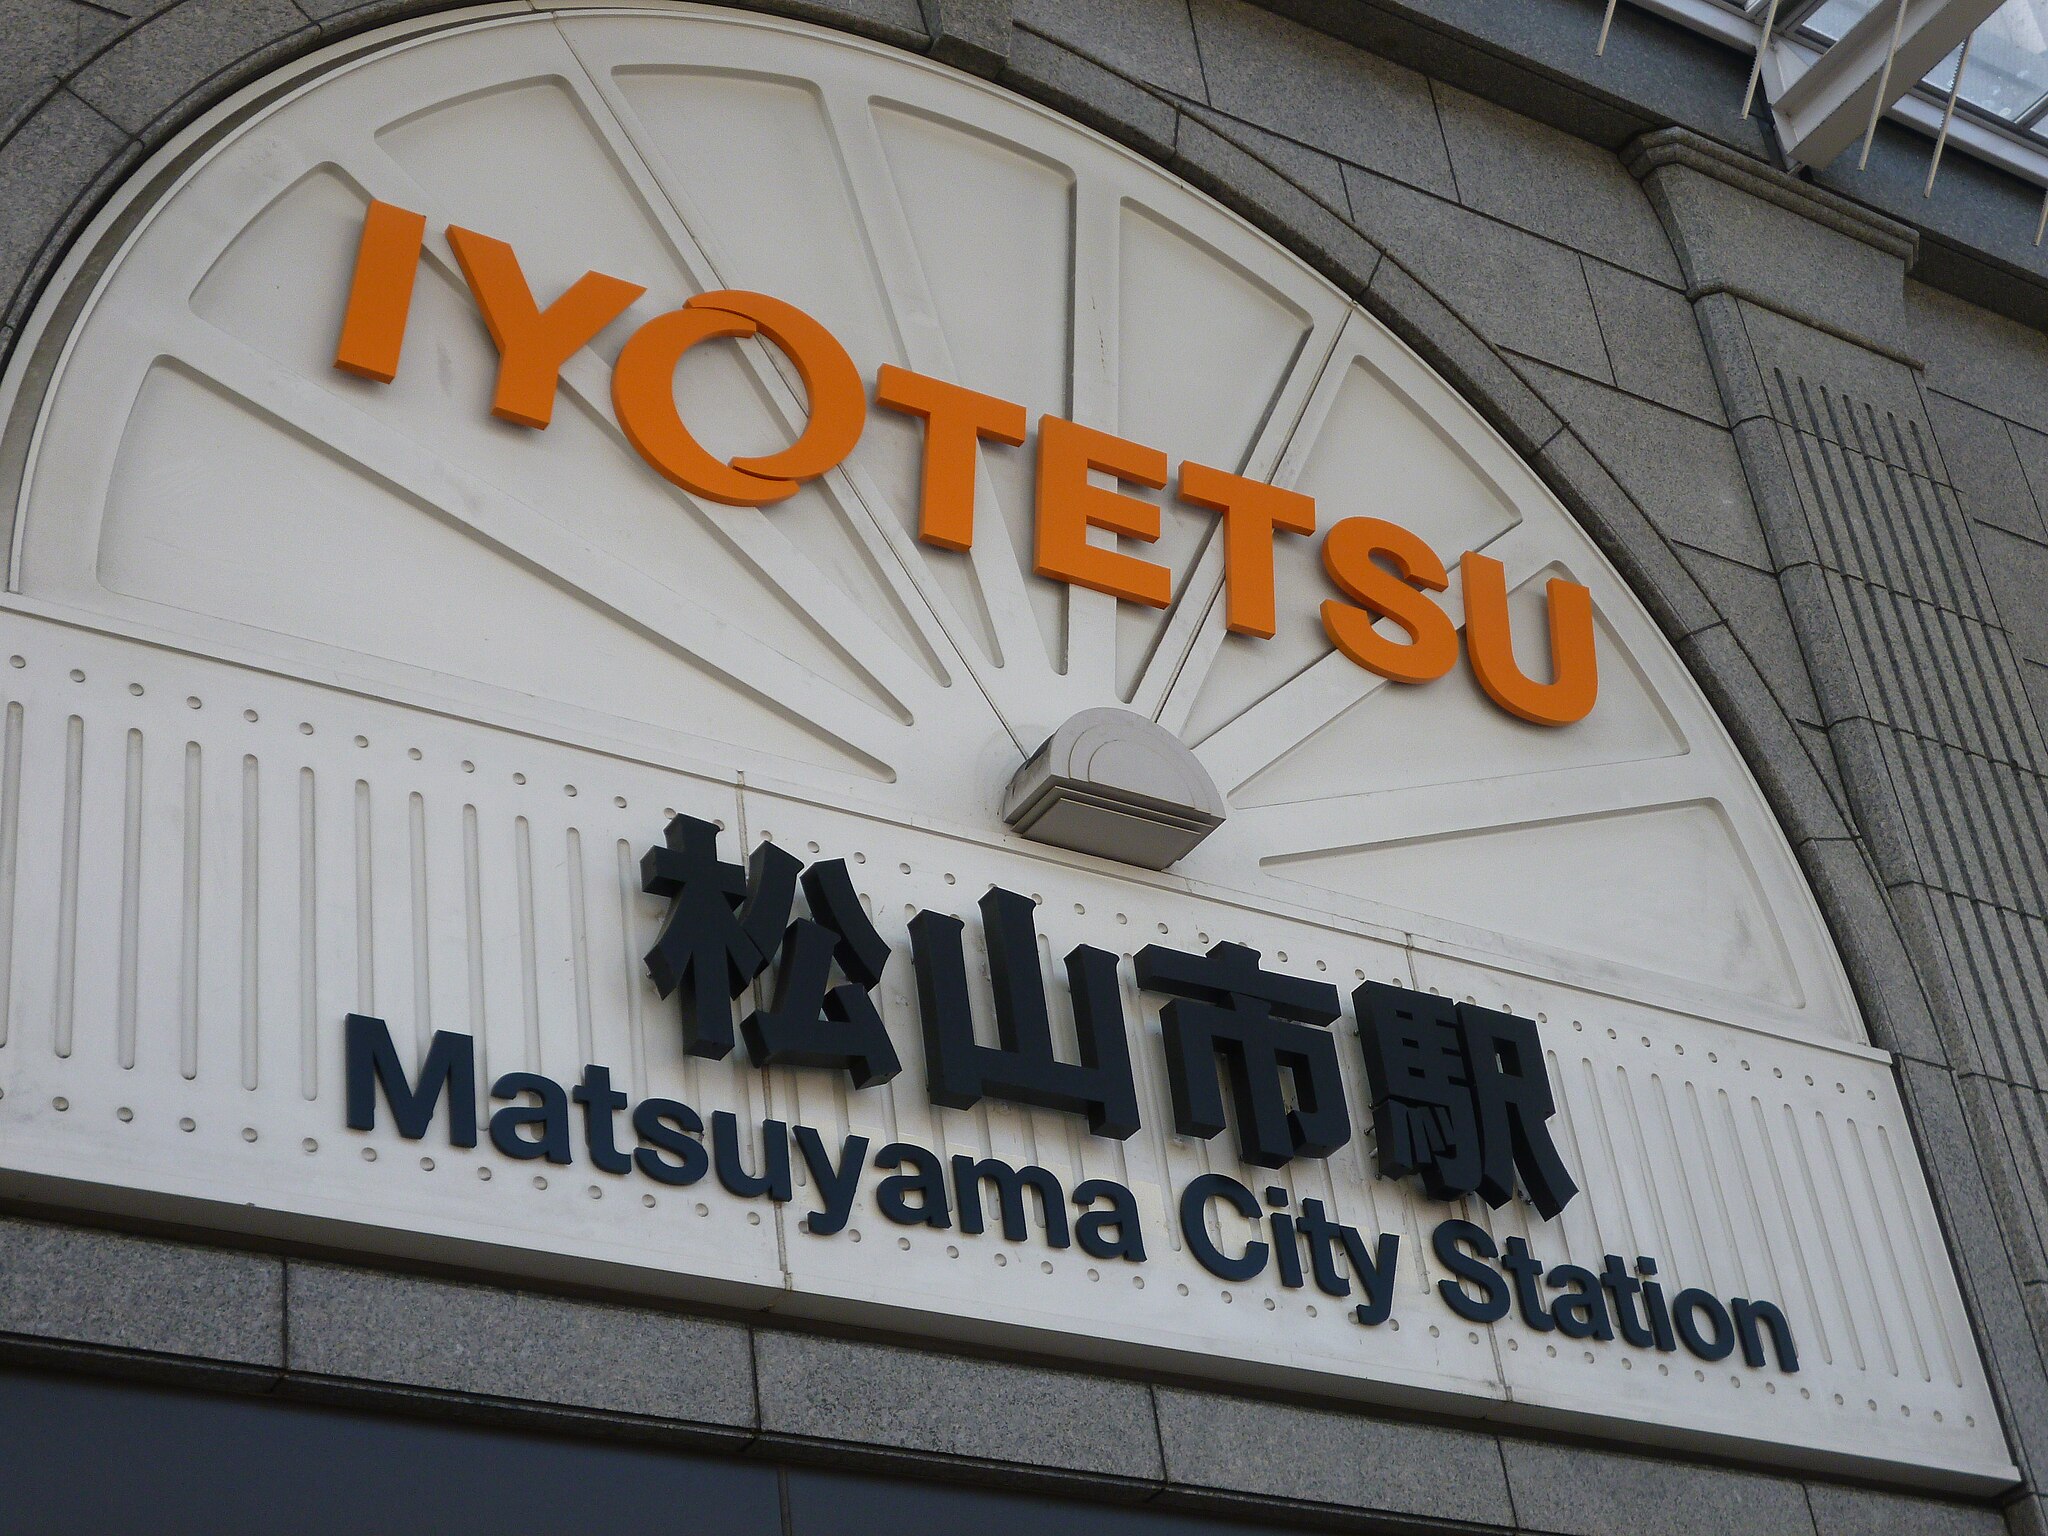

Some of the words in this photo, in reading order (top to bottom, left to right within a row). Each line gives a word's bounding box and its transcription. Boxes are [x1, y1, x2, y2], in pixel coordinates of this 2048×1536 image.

[335, 199, 1600, 726] IYOTETSU
[344, 1012, 1149, 1264] Matsuyama
[1179, 1172, 1400, 1327] City
[1432, 1218, 1800, 1374] Station
[639, 812, 1580, 1222] 松山市駅
